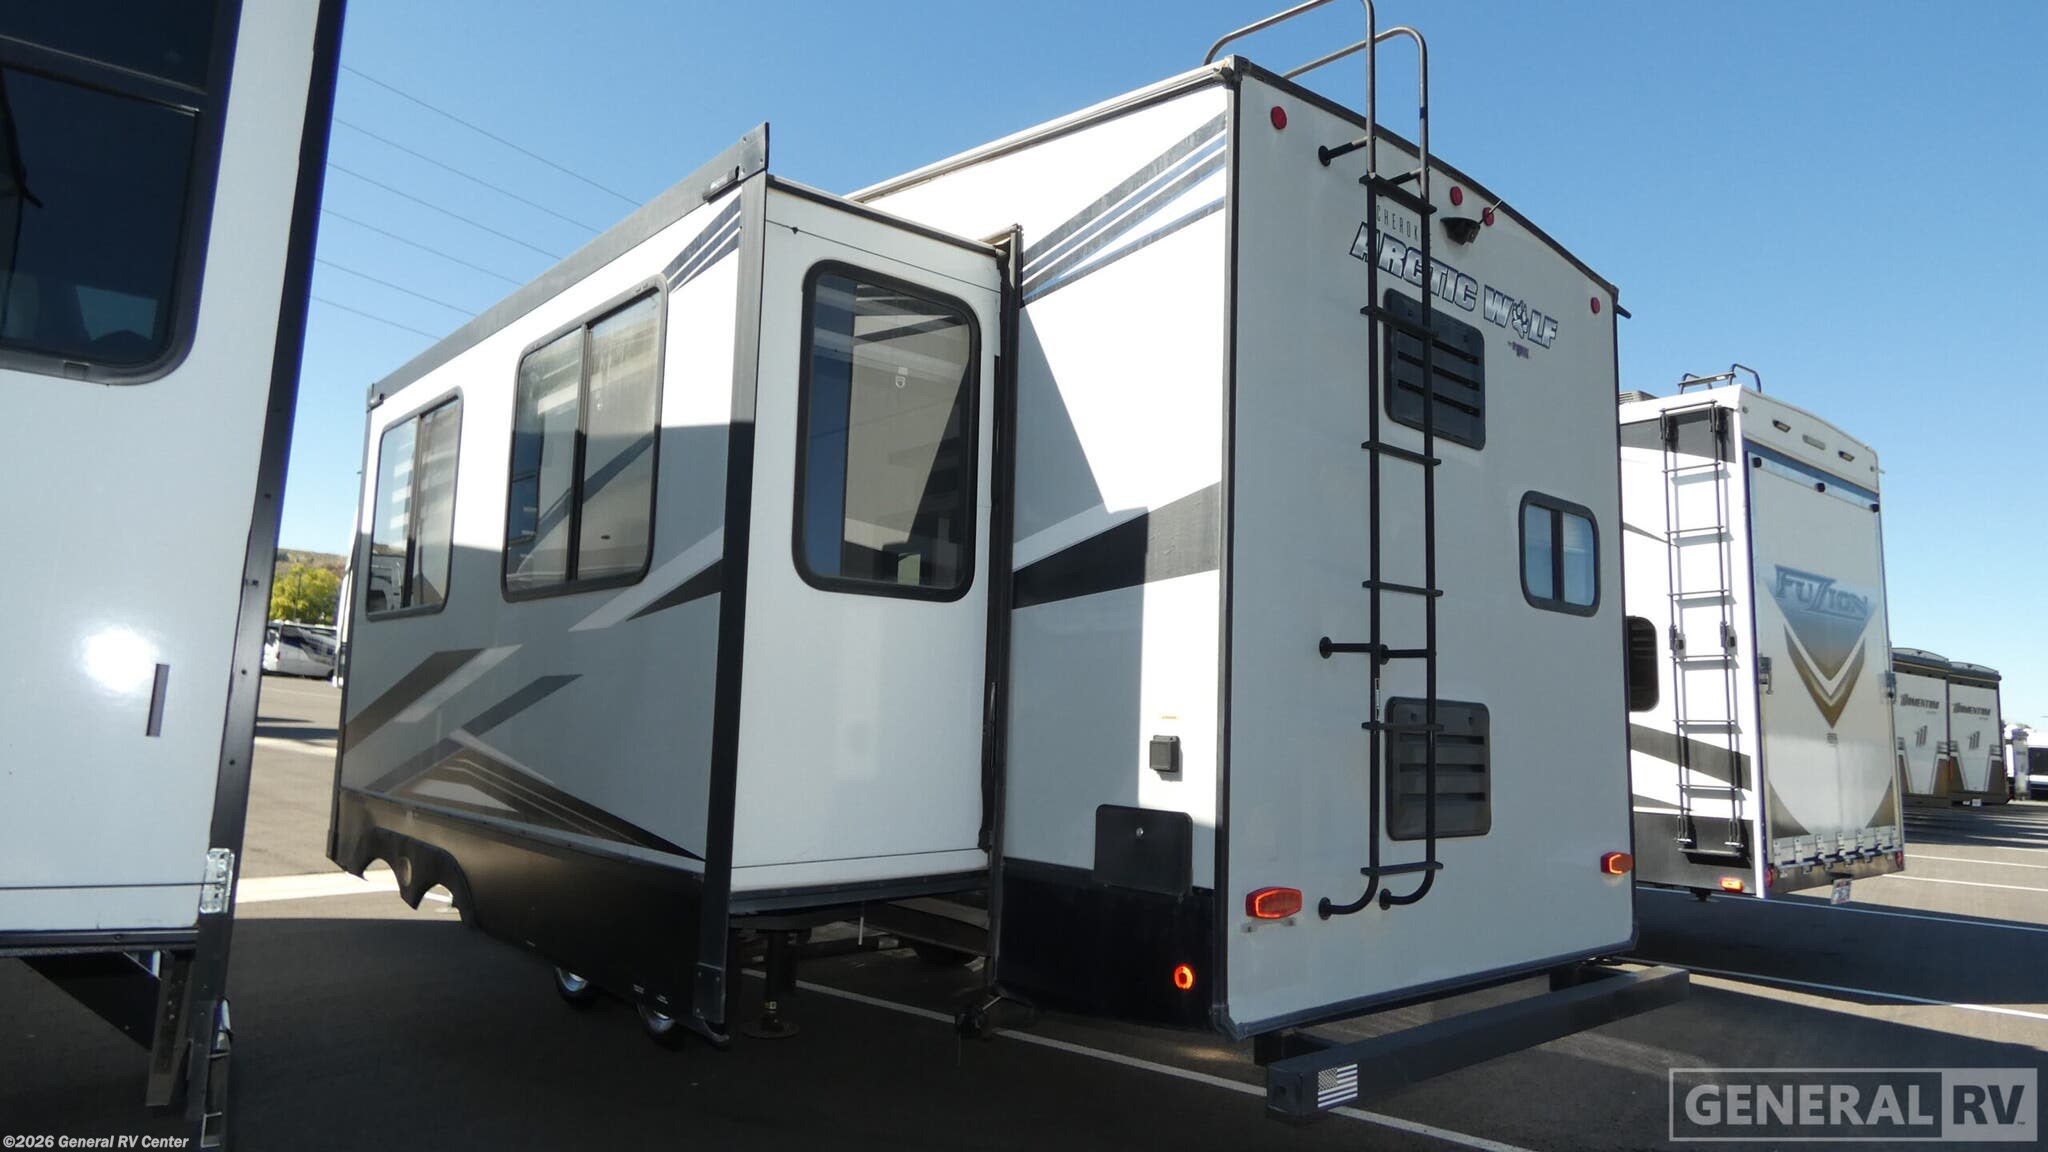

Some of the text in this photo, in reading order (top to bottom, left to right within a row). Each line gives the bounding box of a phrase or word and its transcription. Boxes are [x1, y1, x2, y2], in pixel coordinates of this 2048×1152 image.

[1376, 204, 1431, 248] CHEROK
[1350, 221, 1479, 312] ARCTIC
[1774, 564, 1868, 621] FUZION
